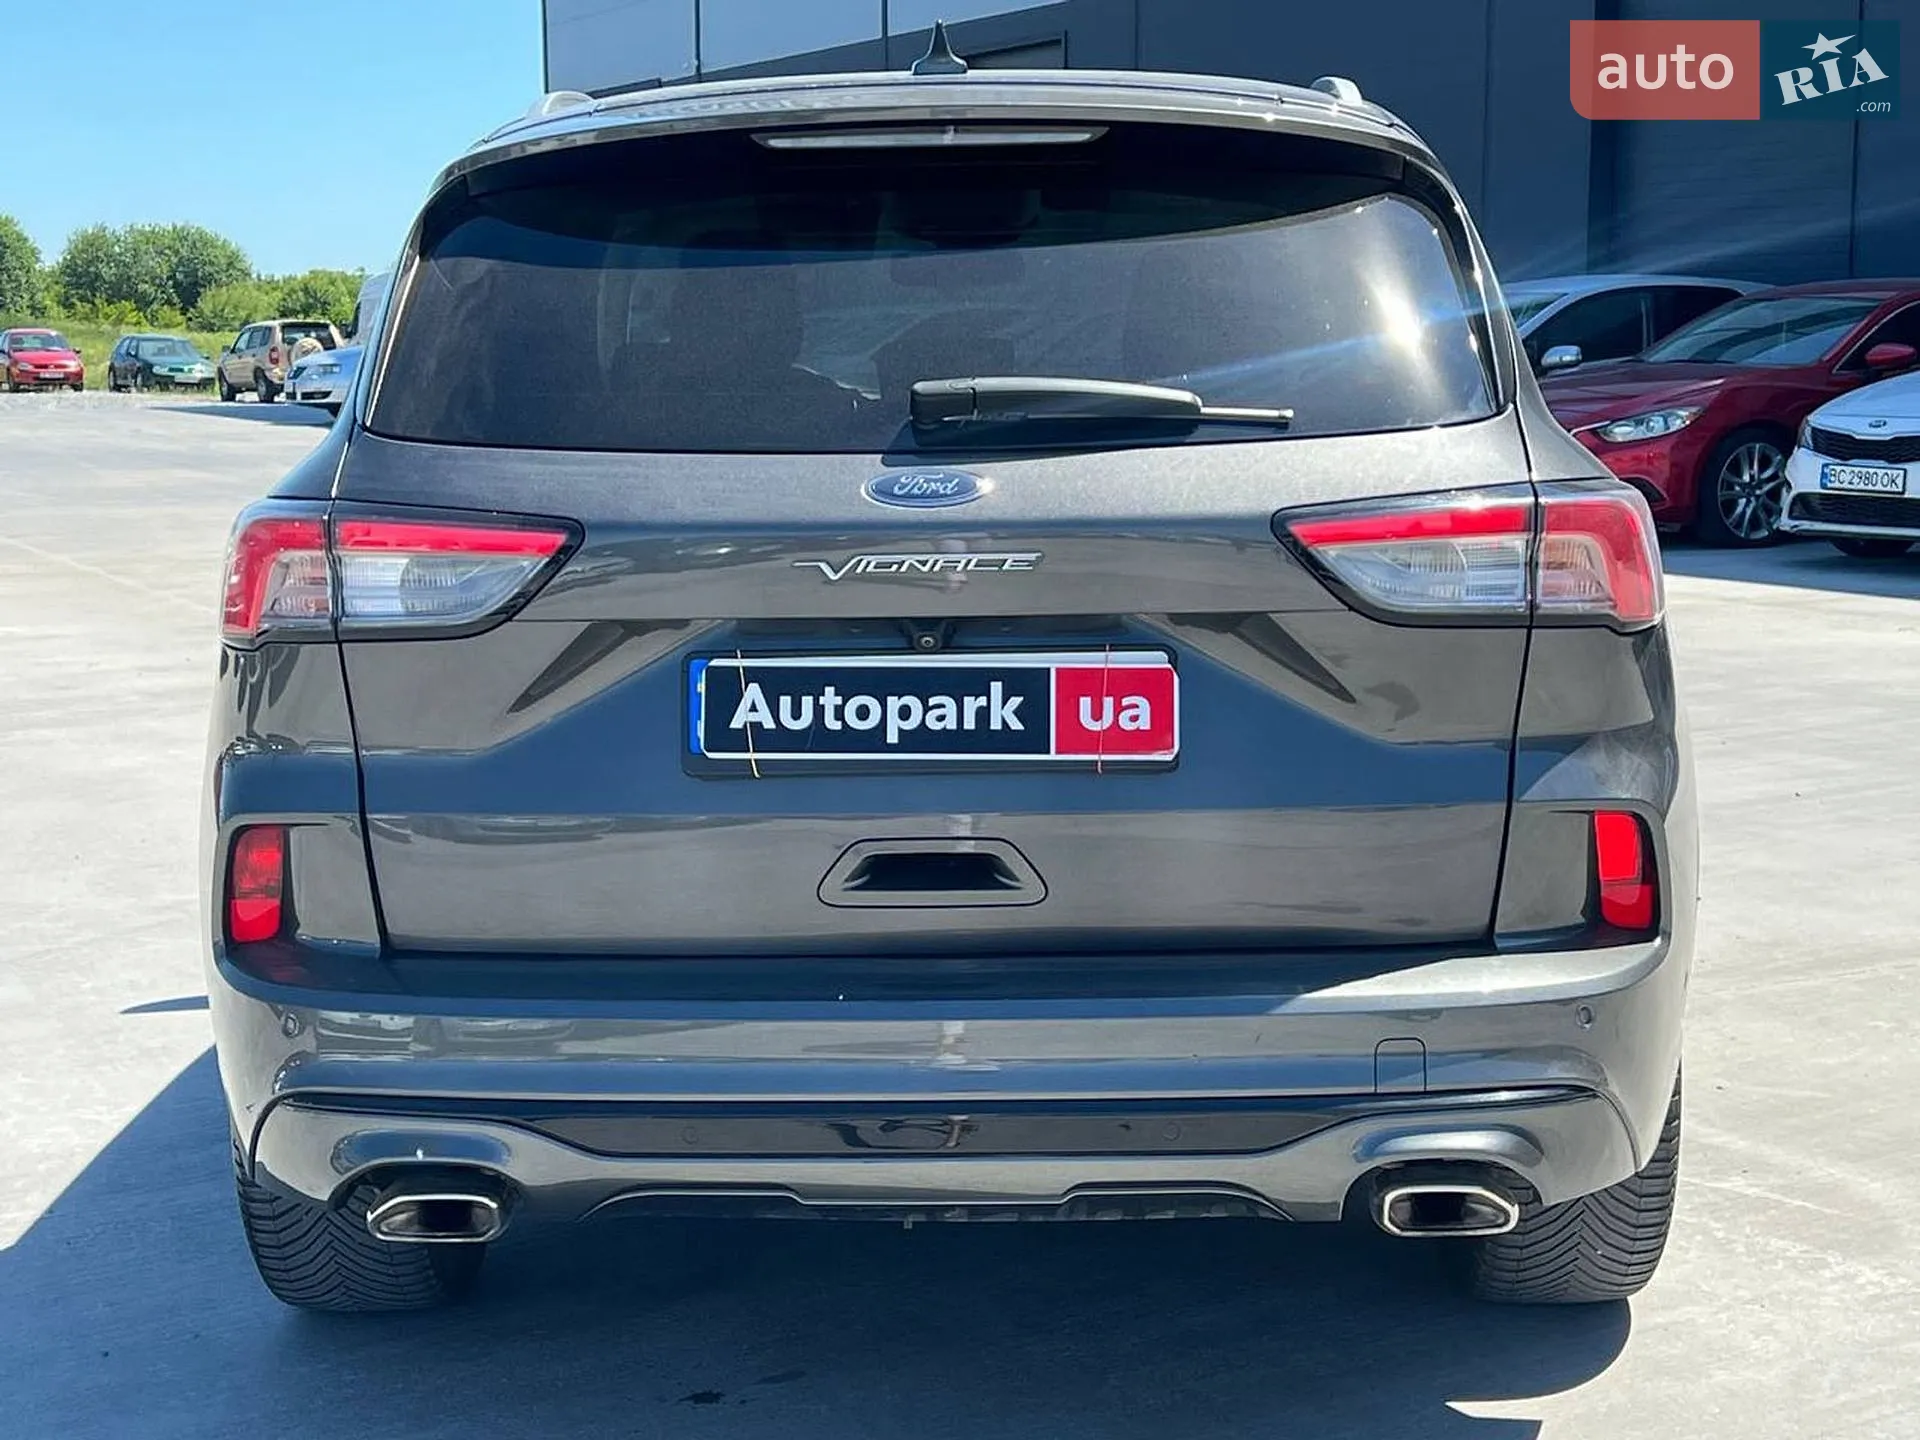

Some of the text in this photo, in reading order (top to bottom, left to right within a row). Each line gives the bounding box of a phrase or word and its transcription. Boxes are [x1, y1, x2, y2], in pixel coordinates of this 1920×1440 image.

[893, 472, 959, 496] Ford
[729, 682, 1152, 744] Autopark ua
